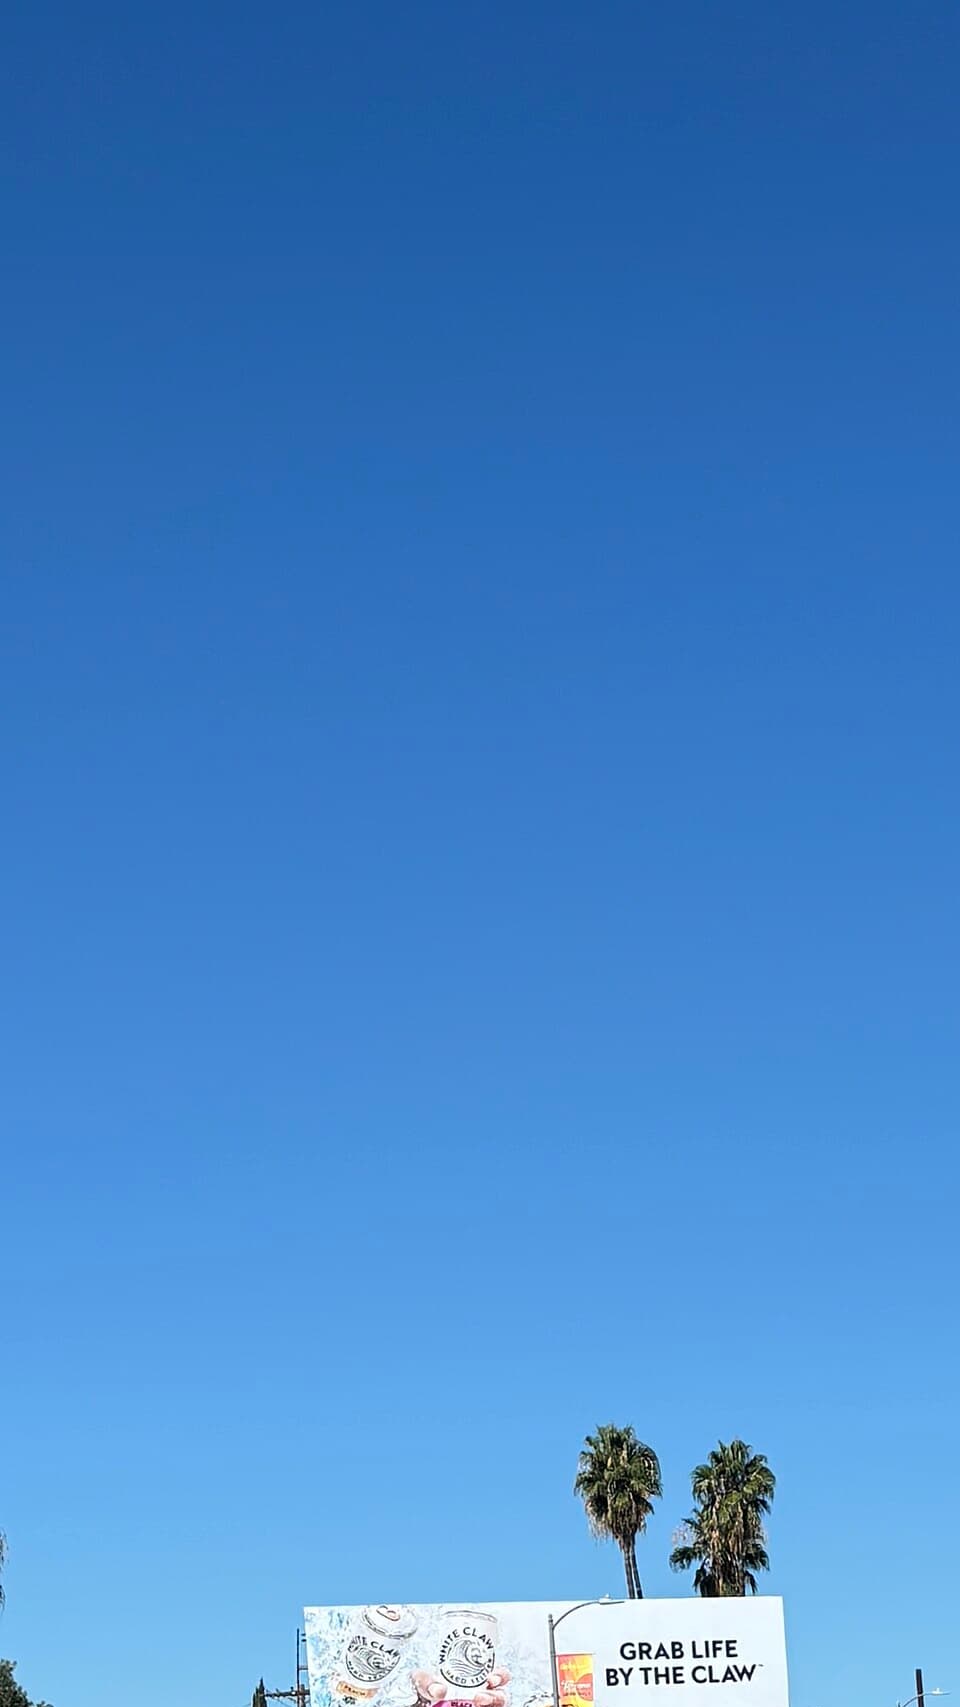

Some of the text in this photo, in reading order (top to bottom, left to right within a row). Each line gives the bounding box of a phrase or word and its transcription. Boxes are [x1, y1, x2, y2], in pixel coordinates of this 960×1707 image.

[439, 1626, 494, 1664] WHITE CLAW
[619, 1639, 738, 1660] GRAB LIFE
[605, 1667, 633, 1686] BY
[639, 1666, 685, 1685] THE
